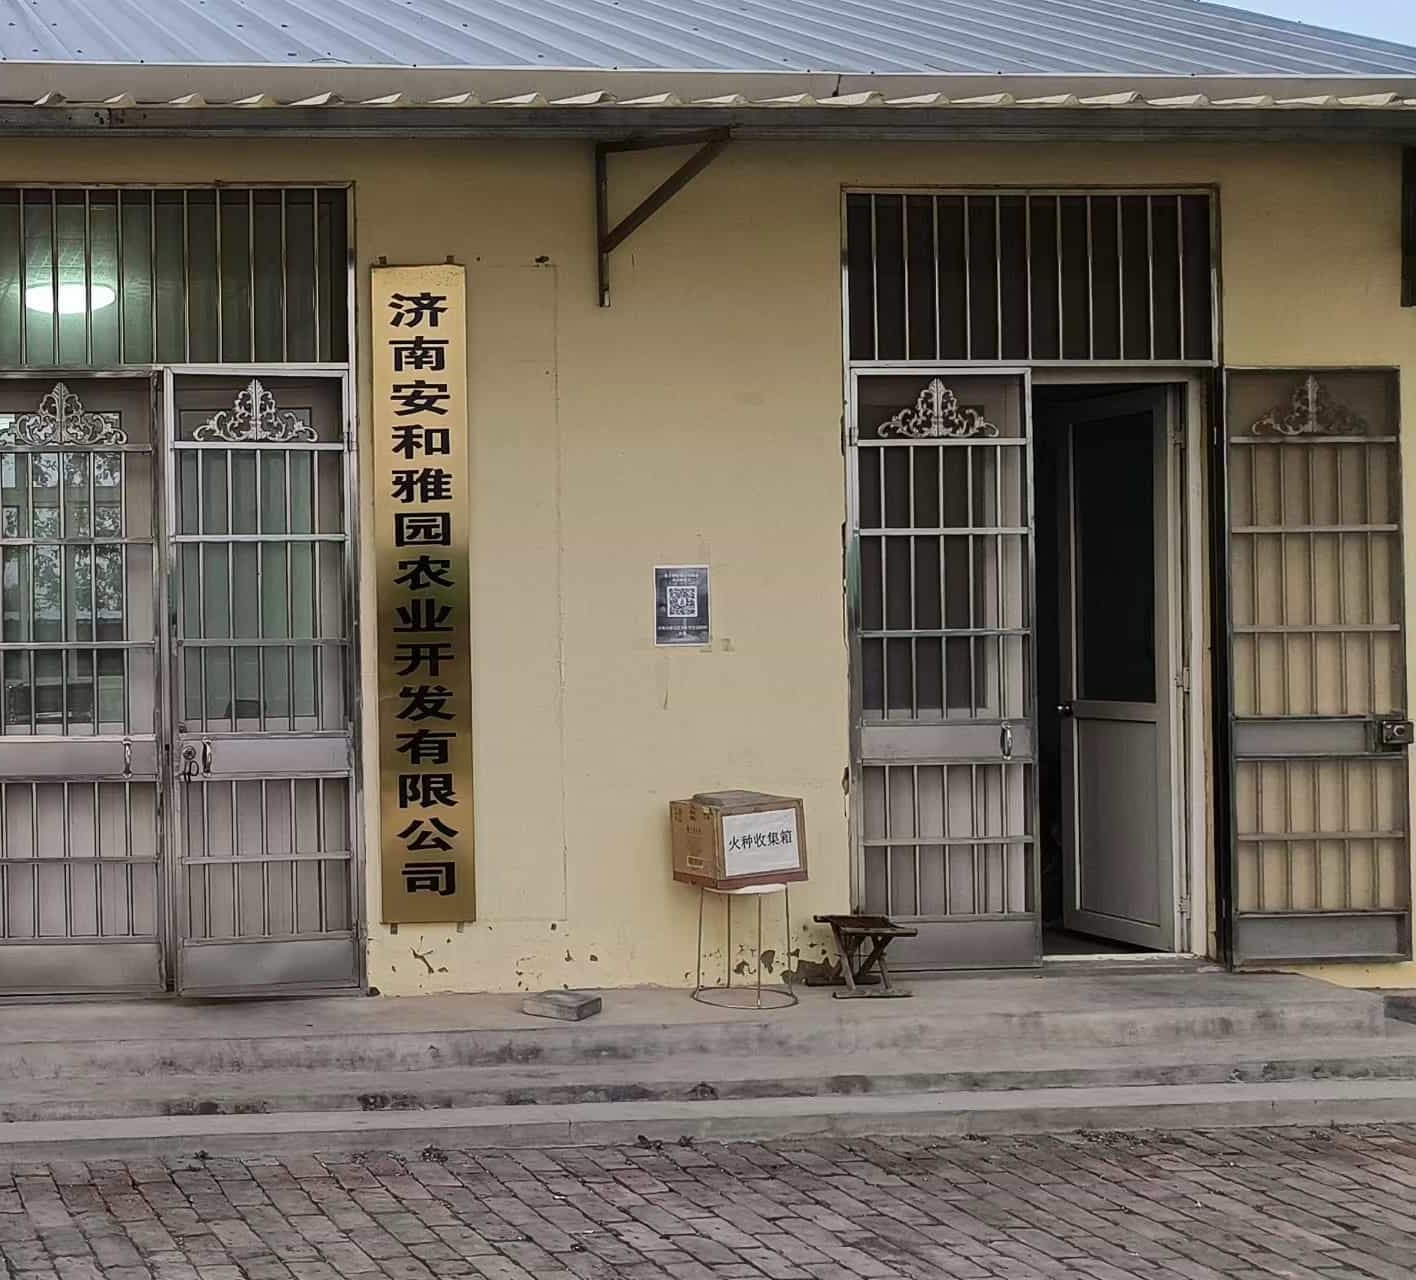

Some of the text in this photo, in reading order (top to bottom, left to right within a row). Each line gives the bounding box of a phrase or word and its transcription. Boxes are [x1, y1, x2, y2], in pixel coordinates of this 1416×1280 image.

[388, 292, 459, 897] 济南安和雅园农业开发有限公司
[728, 829, 793, 852] 火种收集箱
